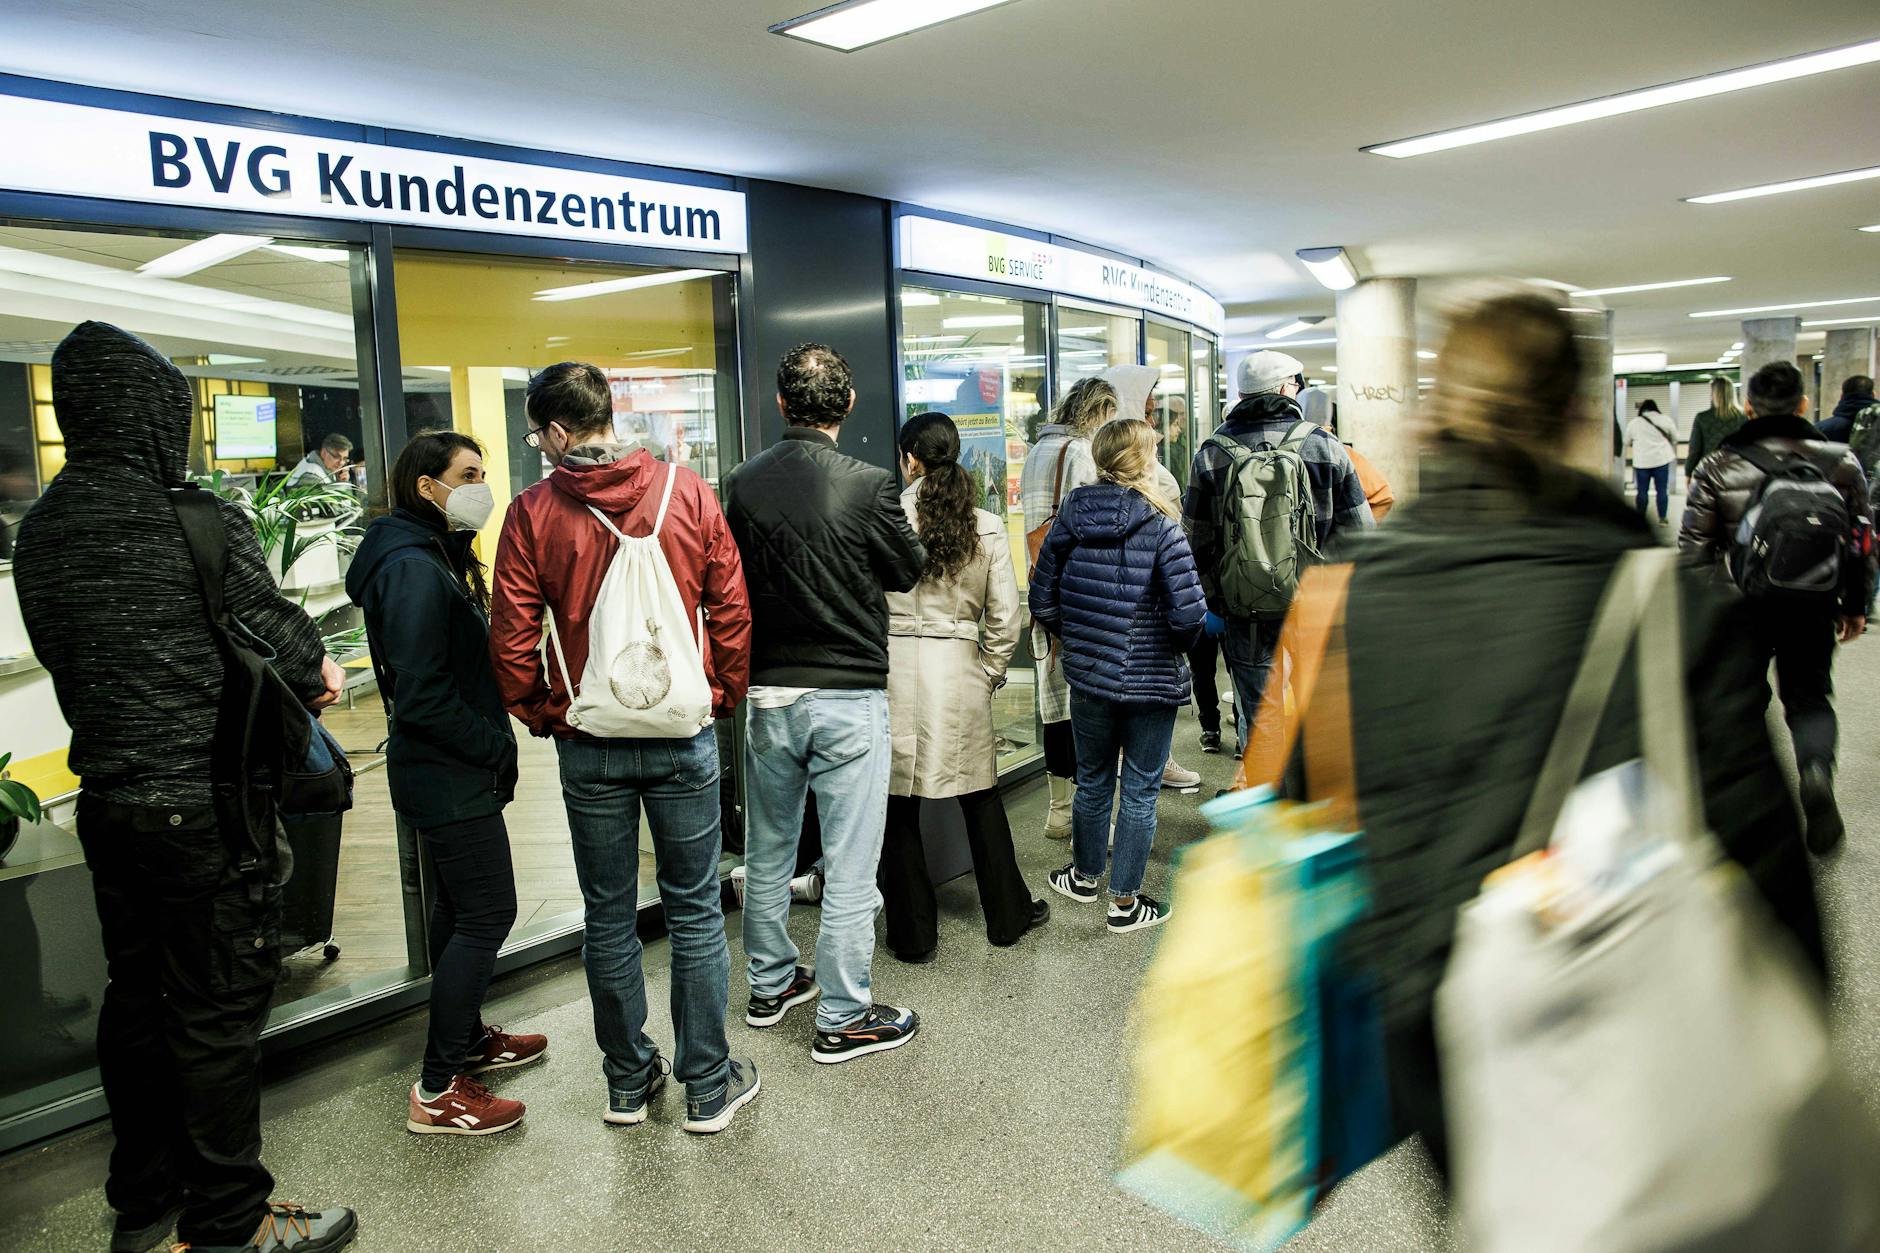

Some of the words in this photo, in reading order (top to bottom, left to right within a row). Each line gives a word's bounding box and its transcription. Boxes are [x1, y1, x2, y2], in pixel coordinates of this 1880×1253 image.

[148, 131, 291, 201] BVG
[317, 152, 722, 241] Kundenzentrum
[988, 255, 1006, 274] BVG
[1009, 259, 1043, 280] SERVICE
